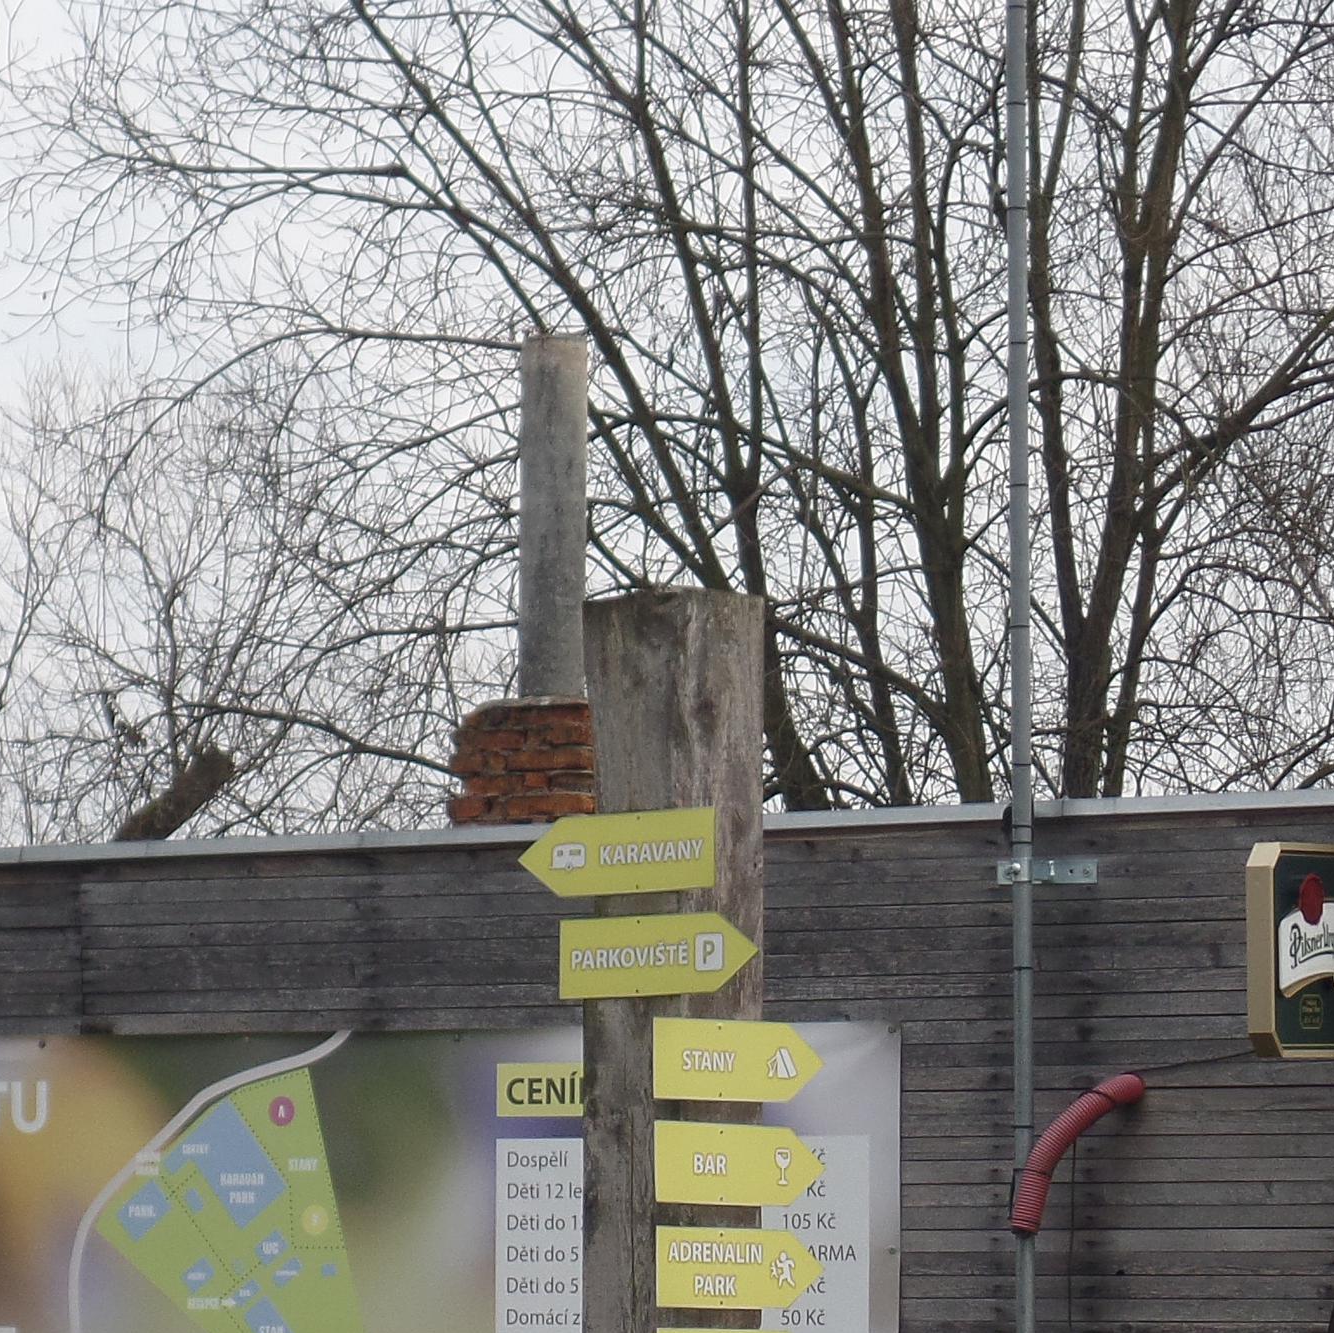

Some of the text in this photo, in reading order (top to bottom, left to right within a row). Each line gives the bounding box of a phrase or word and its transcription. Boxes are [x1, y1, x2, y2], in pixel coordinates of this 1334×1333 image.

[599, 838, 704, 865] KARAVANY
[1289, 922, 1324, 969] Pilsner
[571, 940, 688, 970] PARKOVIŠTĚ
[682, 1050, 736, 1072] STANY
[278, 1104, 285, 1119] A
[288, 1158, 319, 1172] STANY
[506, 1150, 569, 1172] Dospělí
[693, 1153, 727, 1175] BAR
[506, 1182, 583, 1200] Děti 12 le
[506, 1213, 540, 1231] Děti
[544, 1213, 566, 1231] do
[782, 1213, 837, 1230] 105 Kč
[506, 1245, 579, 1263] Děti do 5
[668, 1242, 763, 1264] ADRENALIN
[506, 1276, 579, 1294] Děti do 5
[694, 1275, 737, 1296] PARK
[506, 1308, 581, 1325] Domácí z
[780, 1309, 826, 1326] 50 Kč
